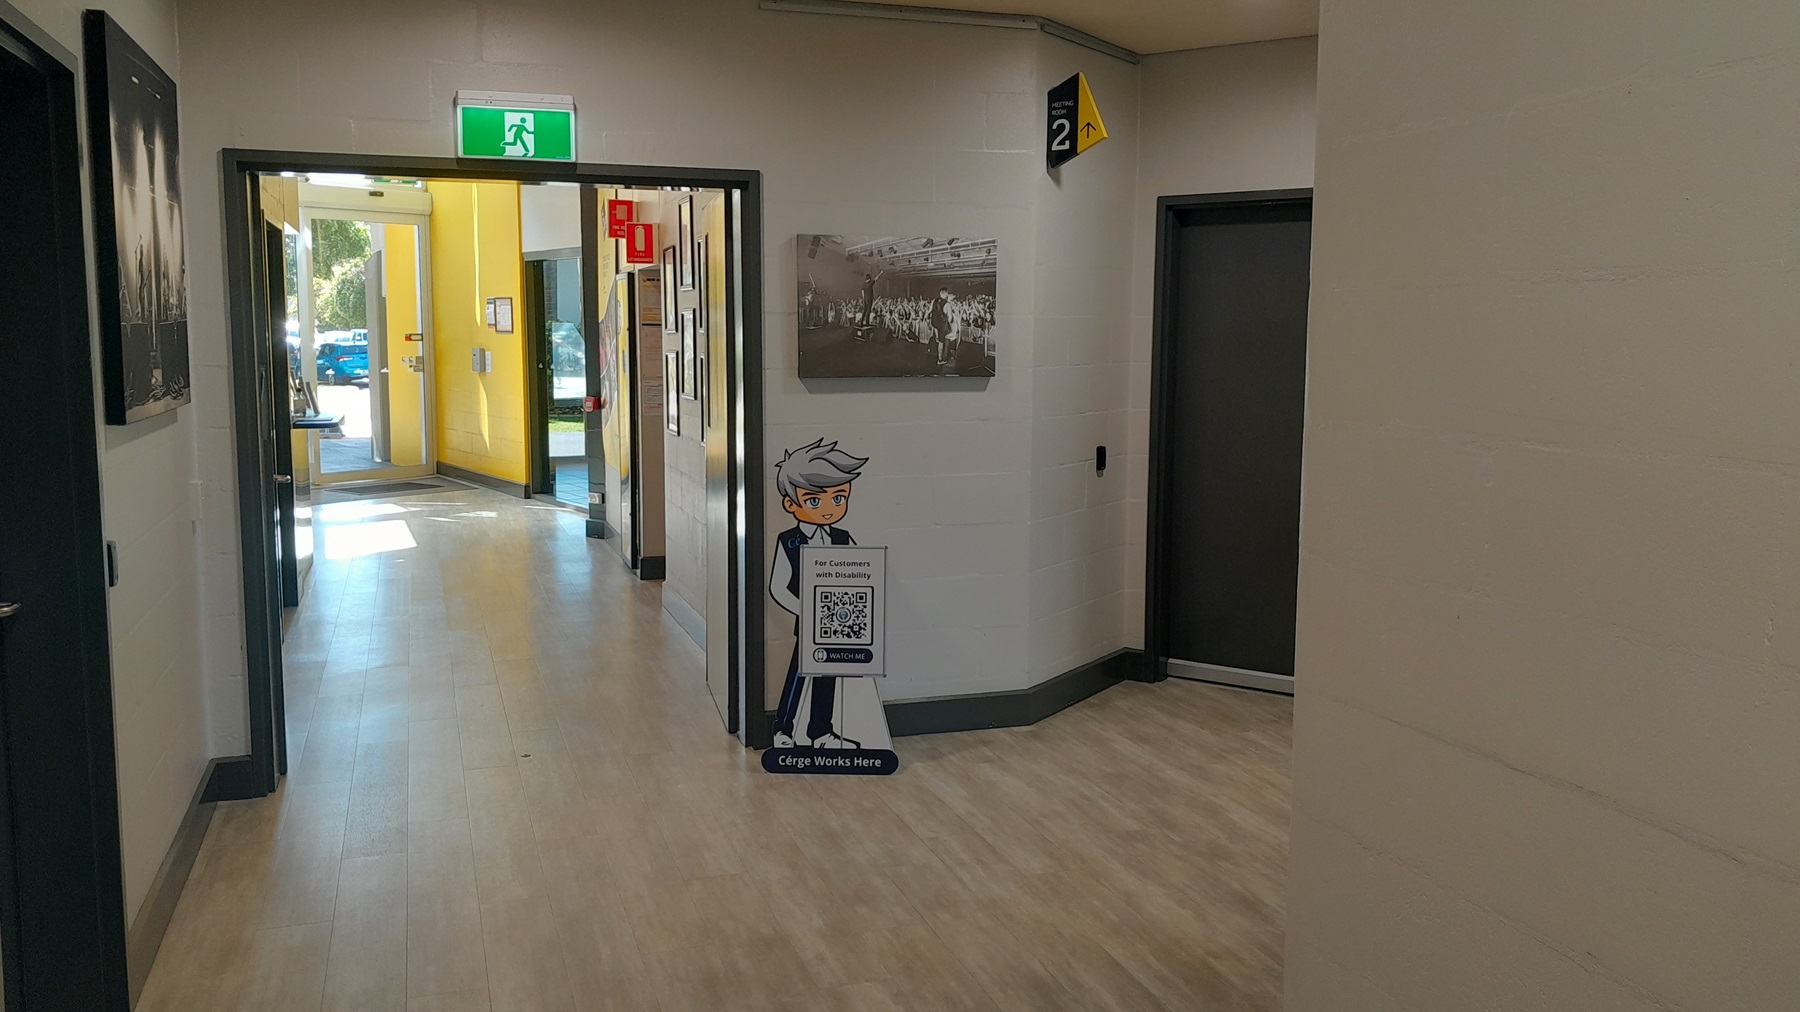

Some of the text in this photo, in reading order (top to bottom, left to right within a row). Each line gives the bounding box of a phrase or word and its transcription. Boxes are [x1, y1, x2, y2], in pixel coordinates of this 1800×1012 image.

[1051, 100, 1074, 108] MEETING
[1051, 118, 1070, 151] 2
[815, 571, 871, 580] with Disability
[778, 755, 882, 768] Cérge Works Here
